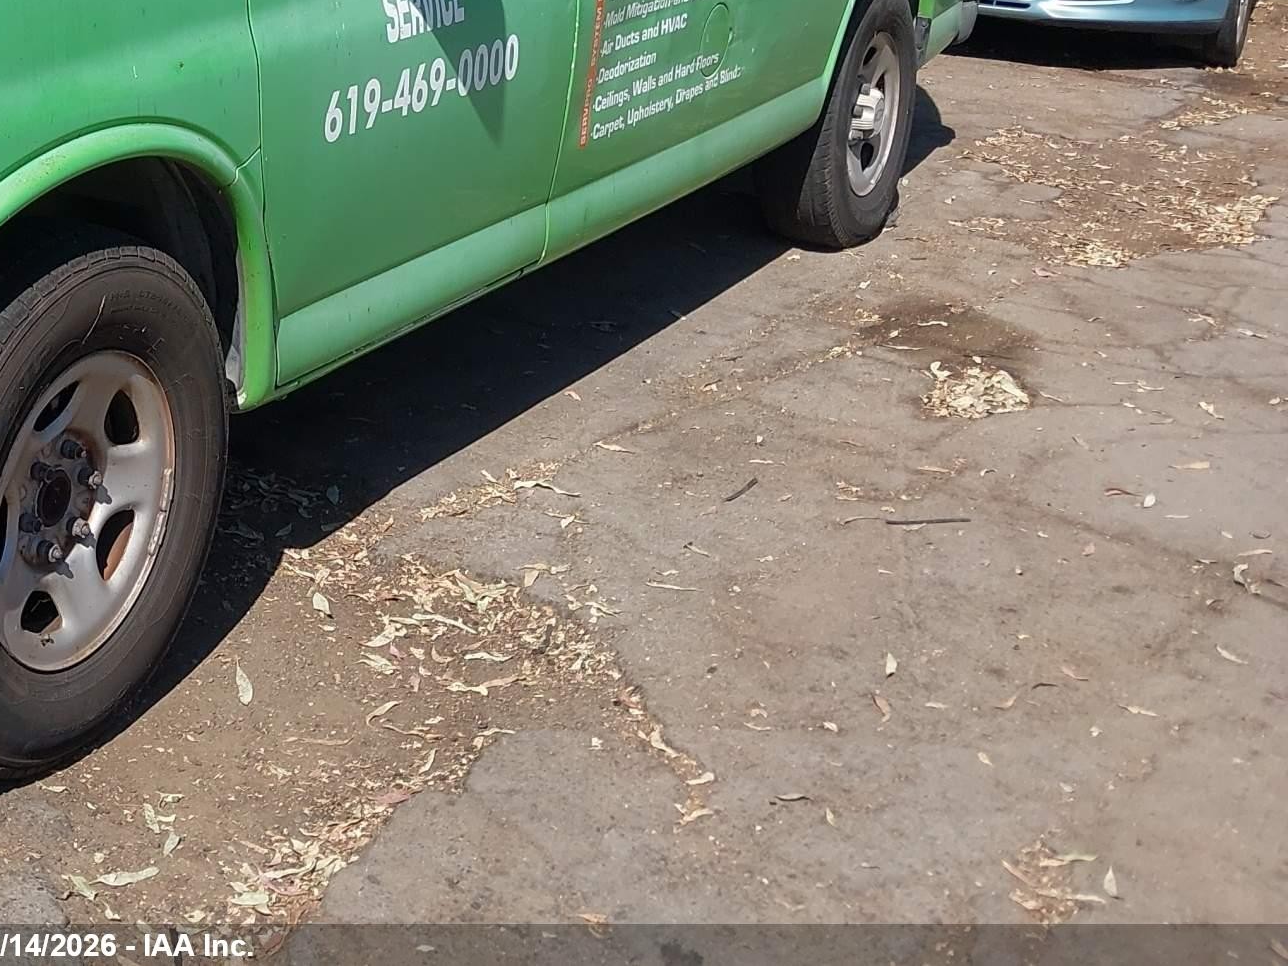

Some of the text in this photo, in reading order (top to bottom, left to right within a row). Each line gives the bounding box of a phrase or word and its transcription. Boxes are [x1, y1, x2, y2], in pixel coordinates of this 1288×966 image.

[601, 13, 688, 57] Air Ducts and HVAC
[605, 6, 626, 29] Mold
[598, 51, 657, 84] Deodorization
[633, 75, 657, 96] Walls
[657, 66, 673, 87] and
[674, 58, 695, 80] Hard
[696, 53, 719, 71] Floors
[325, 34, 519, 143] 619-469-0000
[675, 83, 703, 104] Drapes
[705, 73, 719, 91] and
